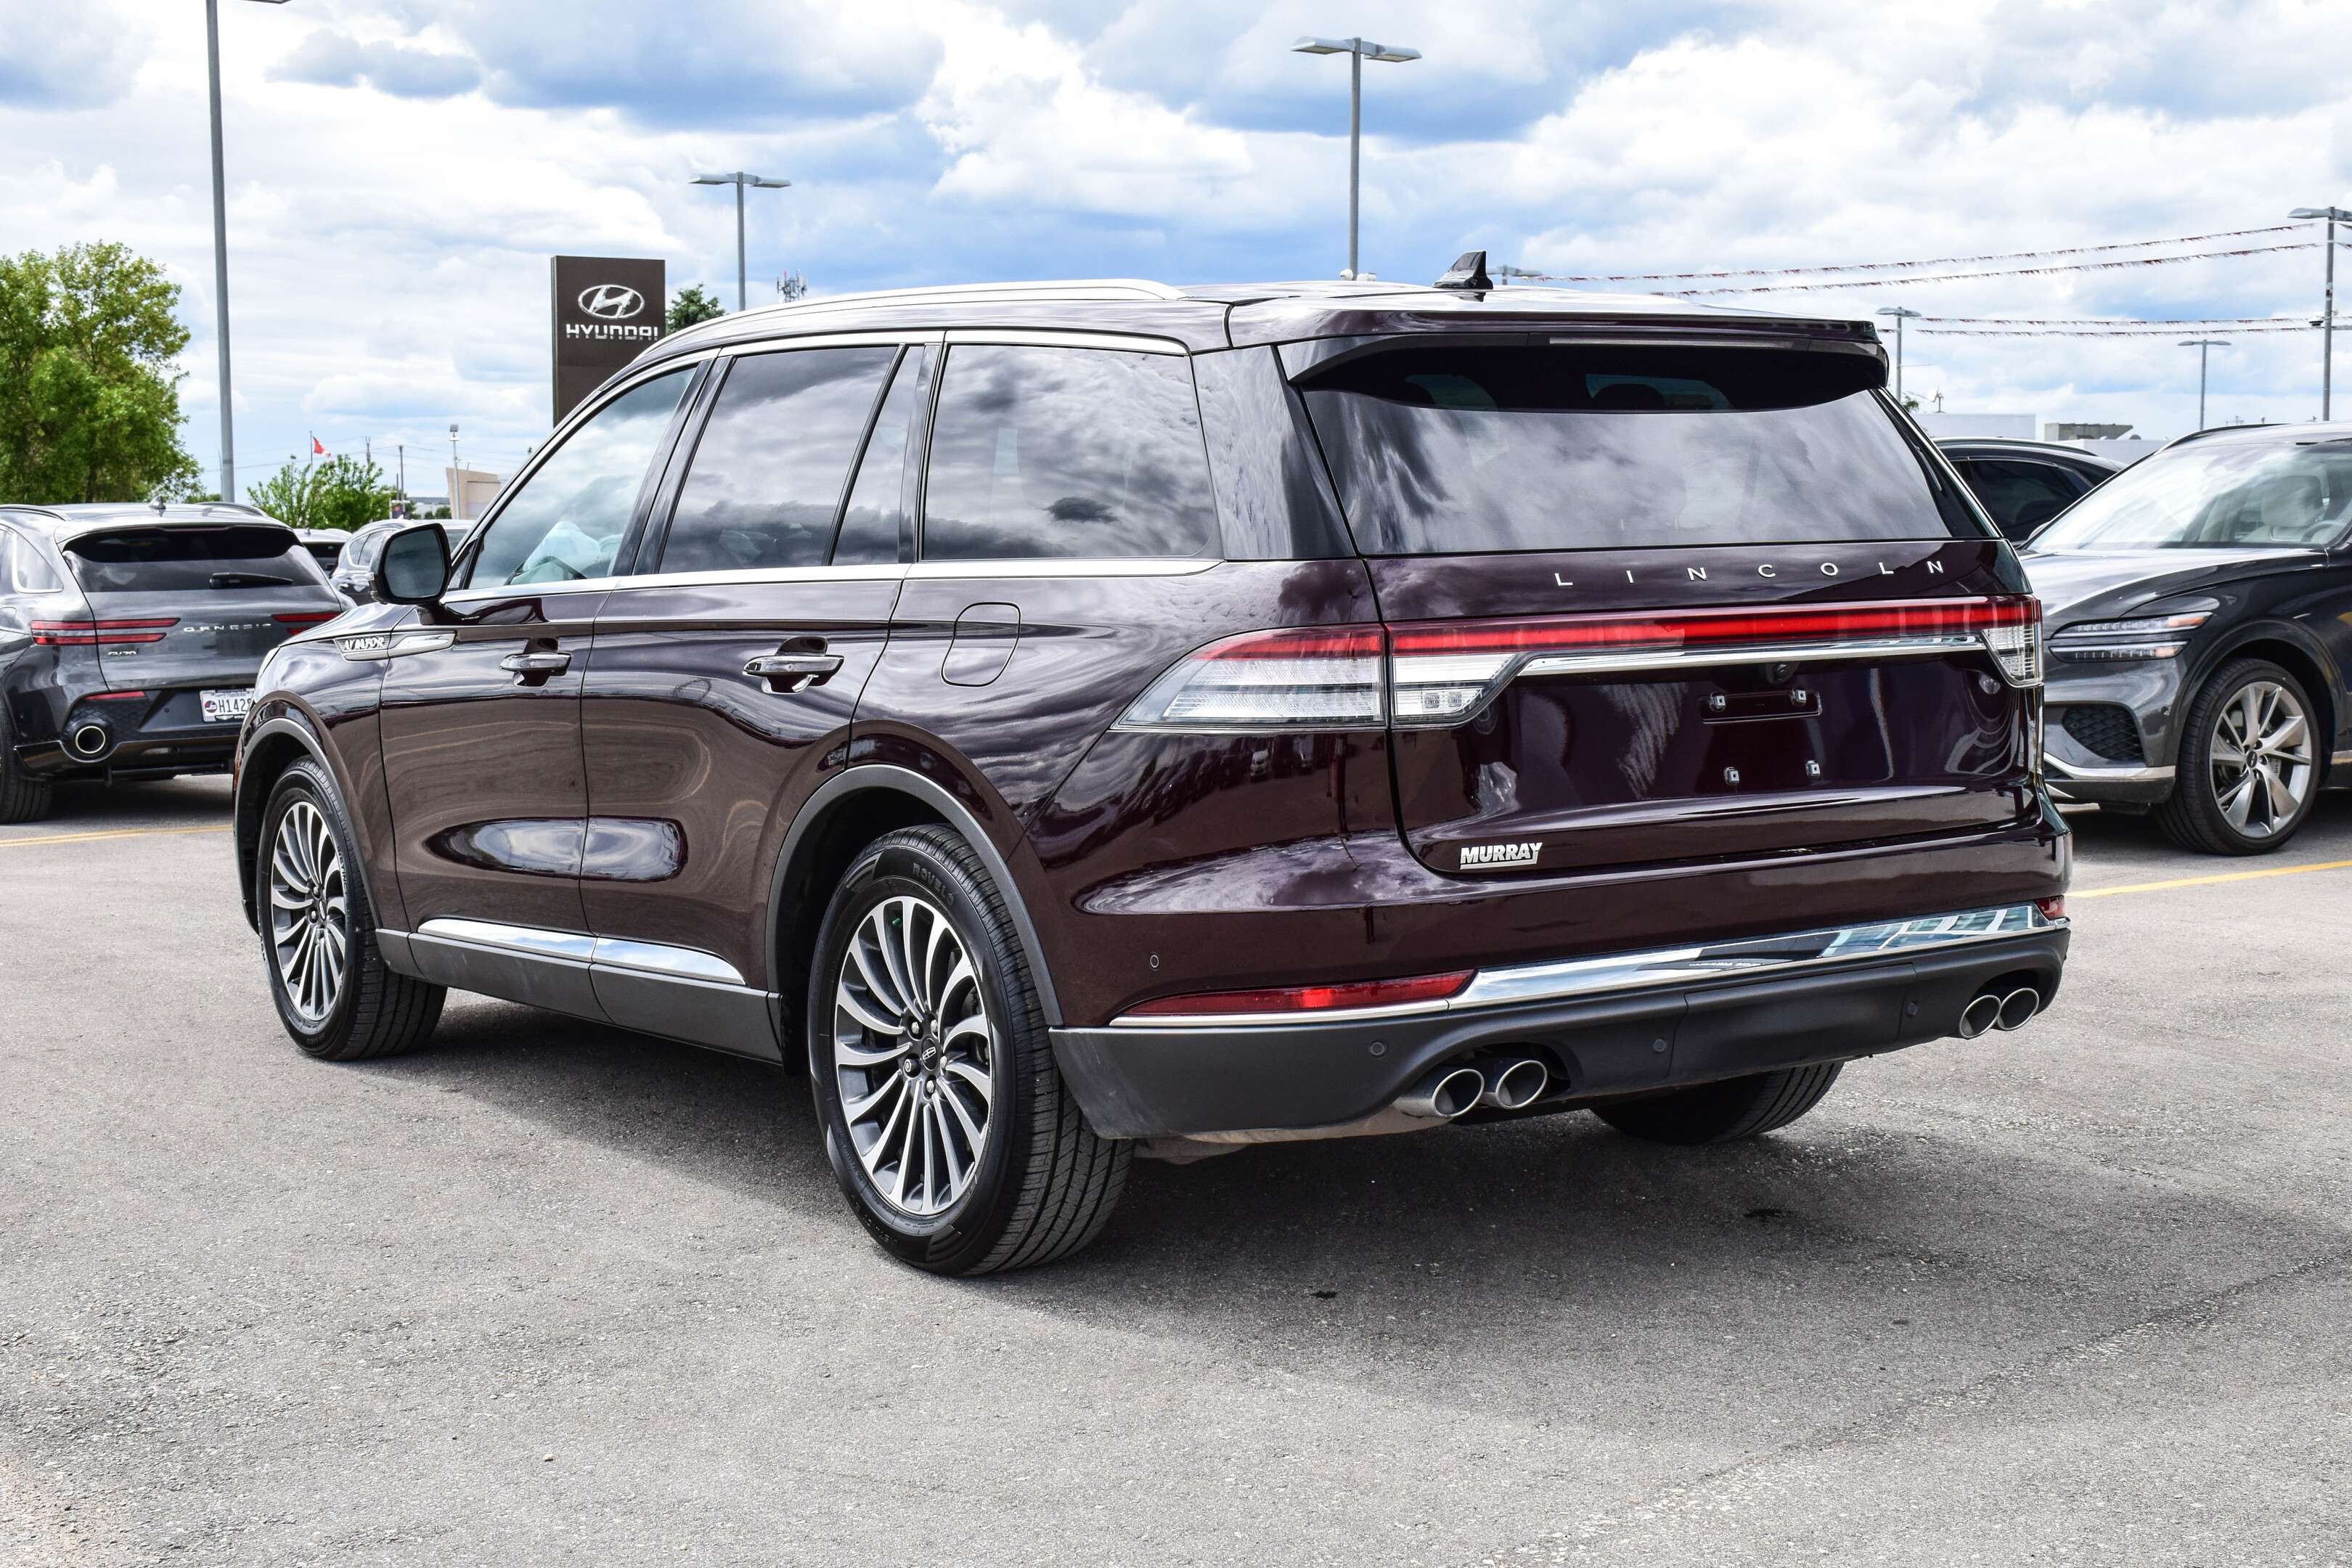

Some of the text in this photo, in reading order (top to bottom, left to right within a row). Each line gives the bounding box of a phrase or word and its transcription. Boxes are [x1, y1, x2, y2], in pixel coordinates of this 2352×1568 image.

[565, 324, 658, 340] HYUNDAI
[1554, 560, 1945, 587] LINCOLN
[1460, 842, 1543, 865] MURRAY
